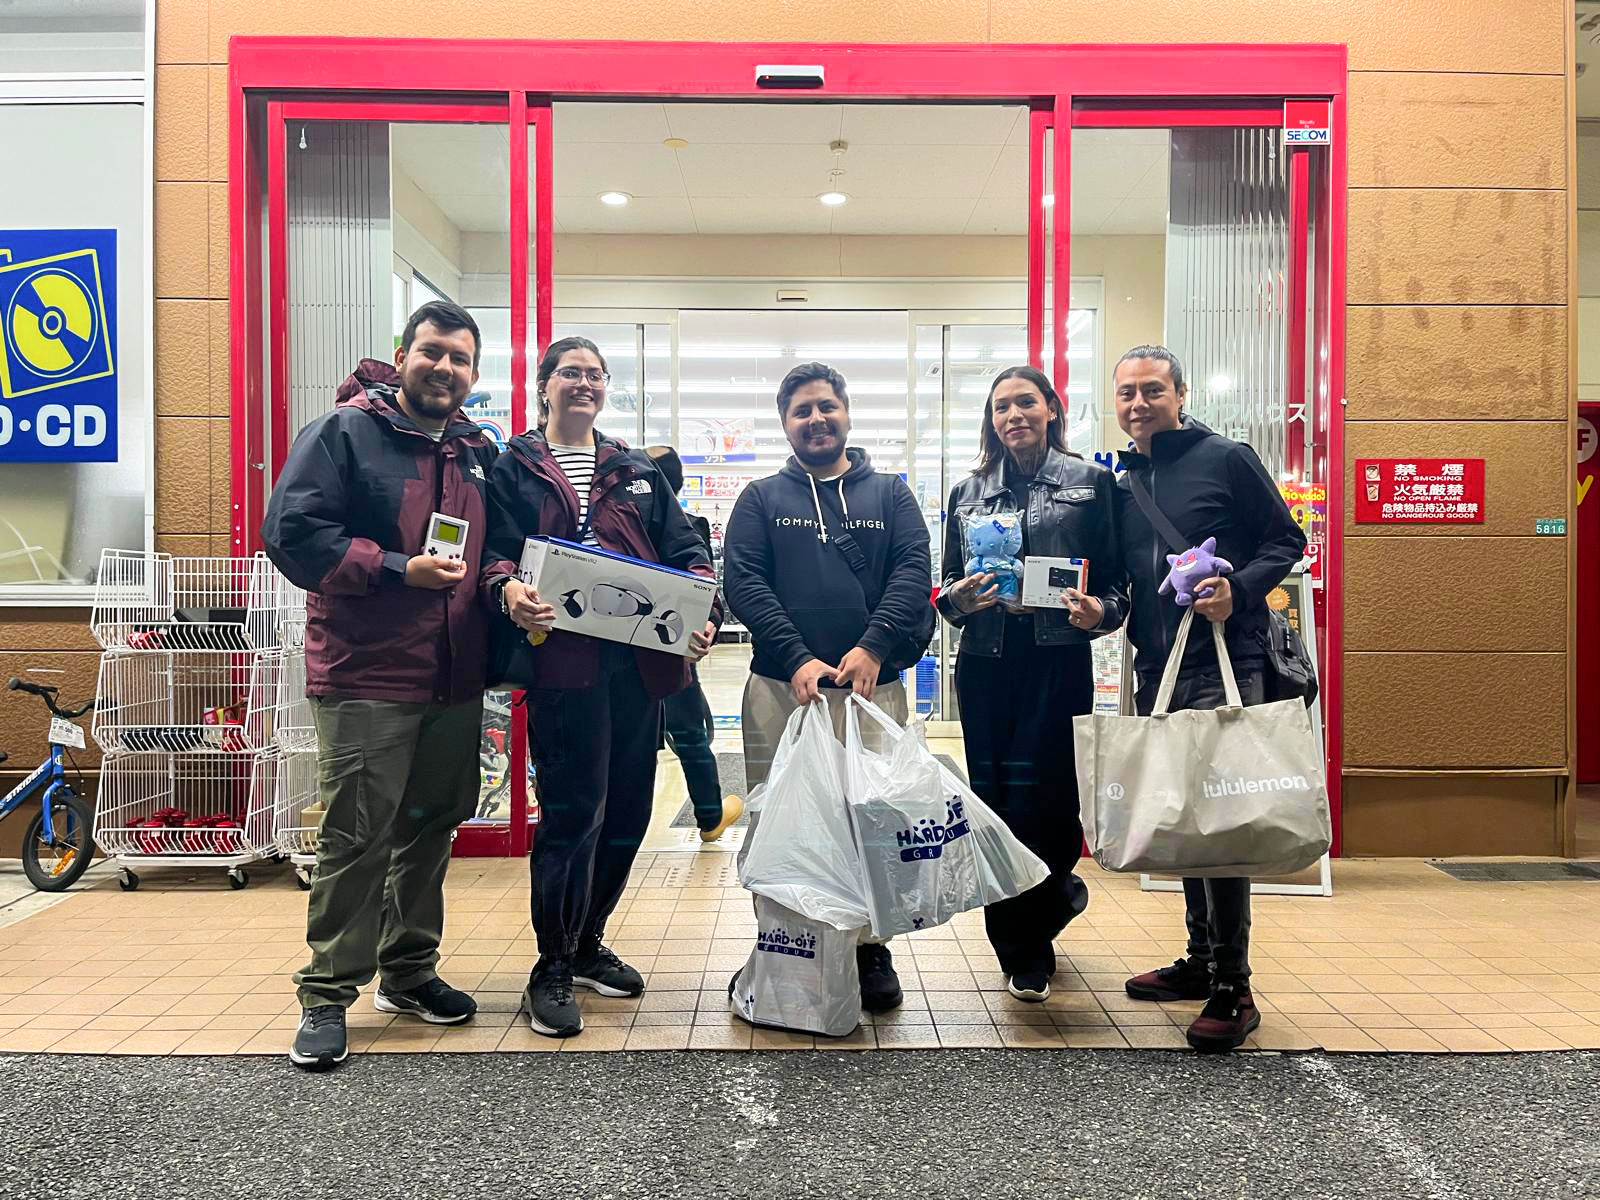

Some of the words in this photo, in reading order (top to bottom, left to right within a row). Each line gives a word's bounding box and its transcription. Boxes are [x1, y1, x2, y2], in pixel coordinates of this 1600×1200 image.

[1287, 130, 1327, 140] SECOM
[1394, 484, 1464, 496] 火気厳禁
[1536, 524, 1565, 534] 5816
[693, 583, 712, 592] SONY
[1202, 776, 1310, 798] lululemon
